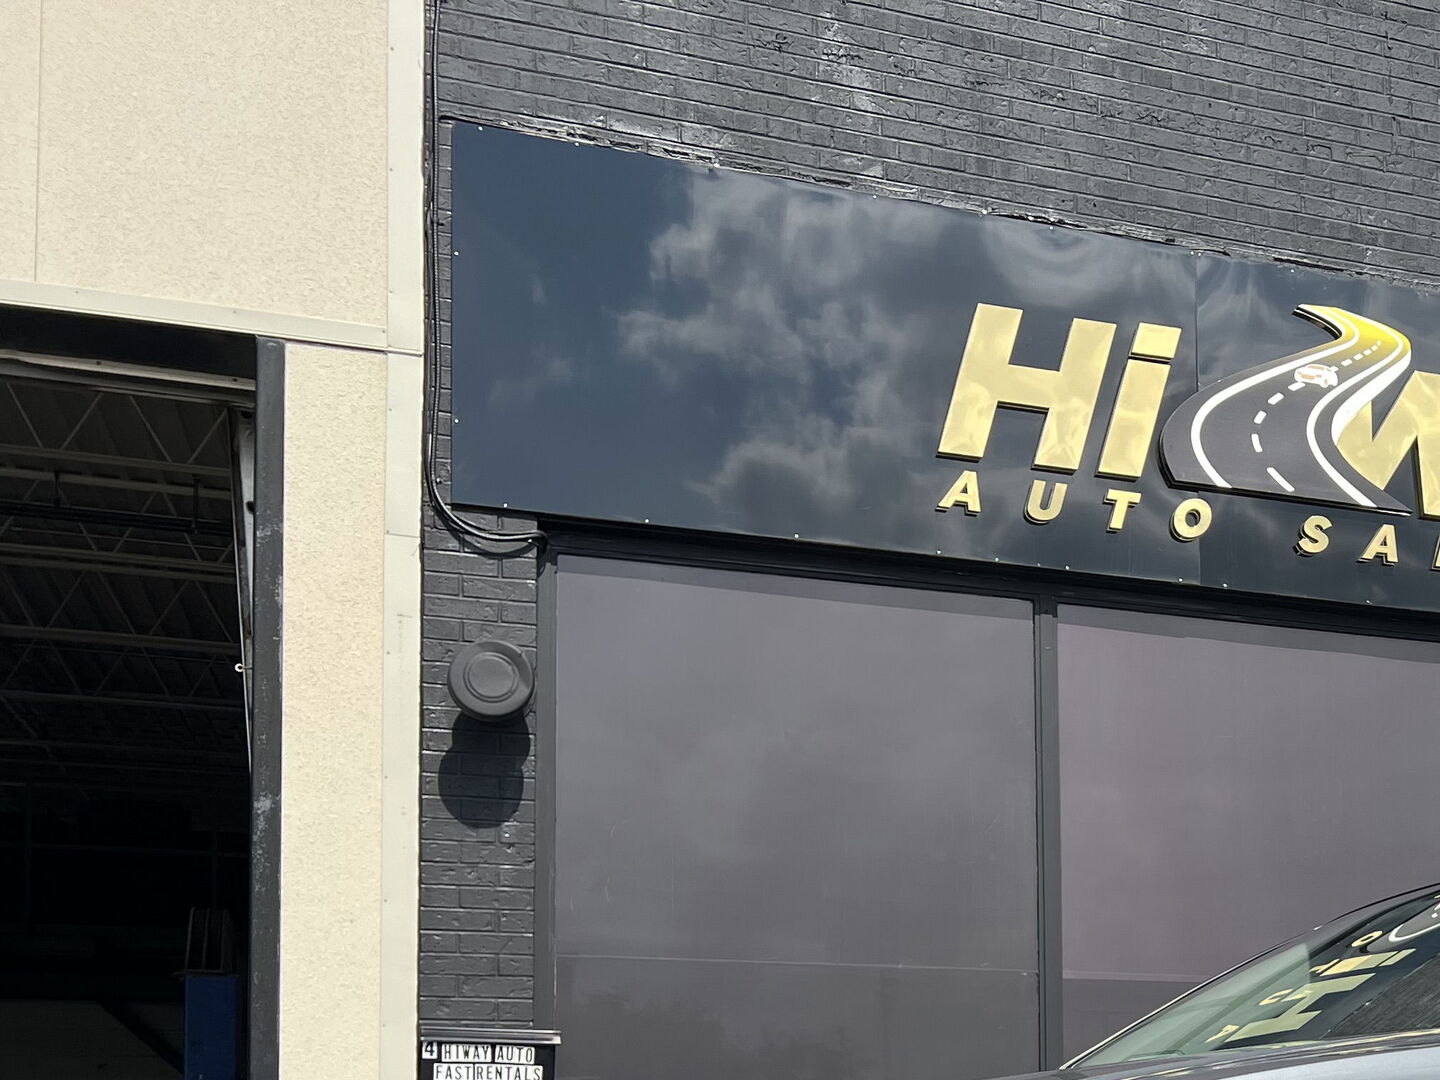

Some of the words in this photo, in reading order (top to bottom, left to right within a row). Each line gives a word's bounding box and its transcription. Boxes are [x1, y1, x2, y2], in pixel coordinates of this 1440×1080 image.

[935, 302, 1183, 481] Hi
[936, 470, 1215, 543] AUTO
[435, 1065, 472, 1080] FAST
[443, 1044, 490, 1061] HIWAY
[496, 1046, 533, 1063] AUTO
